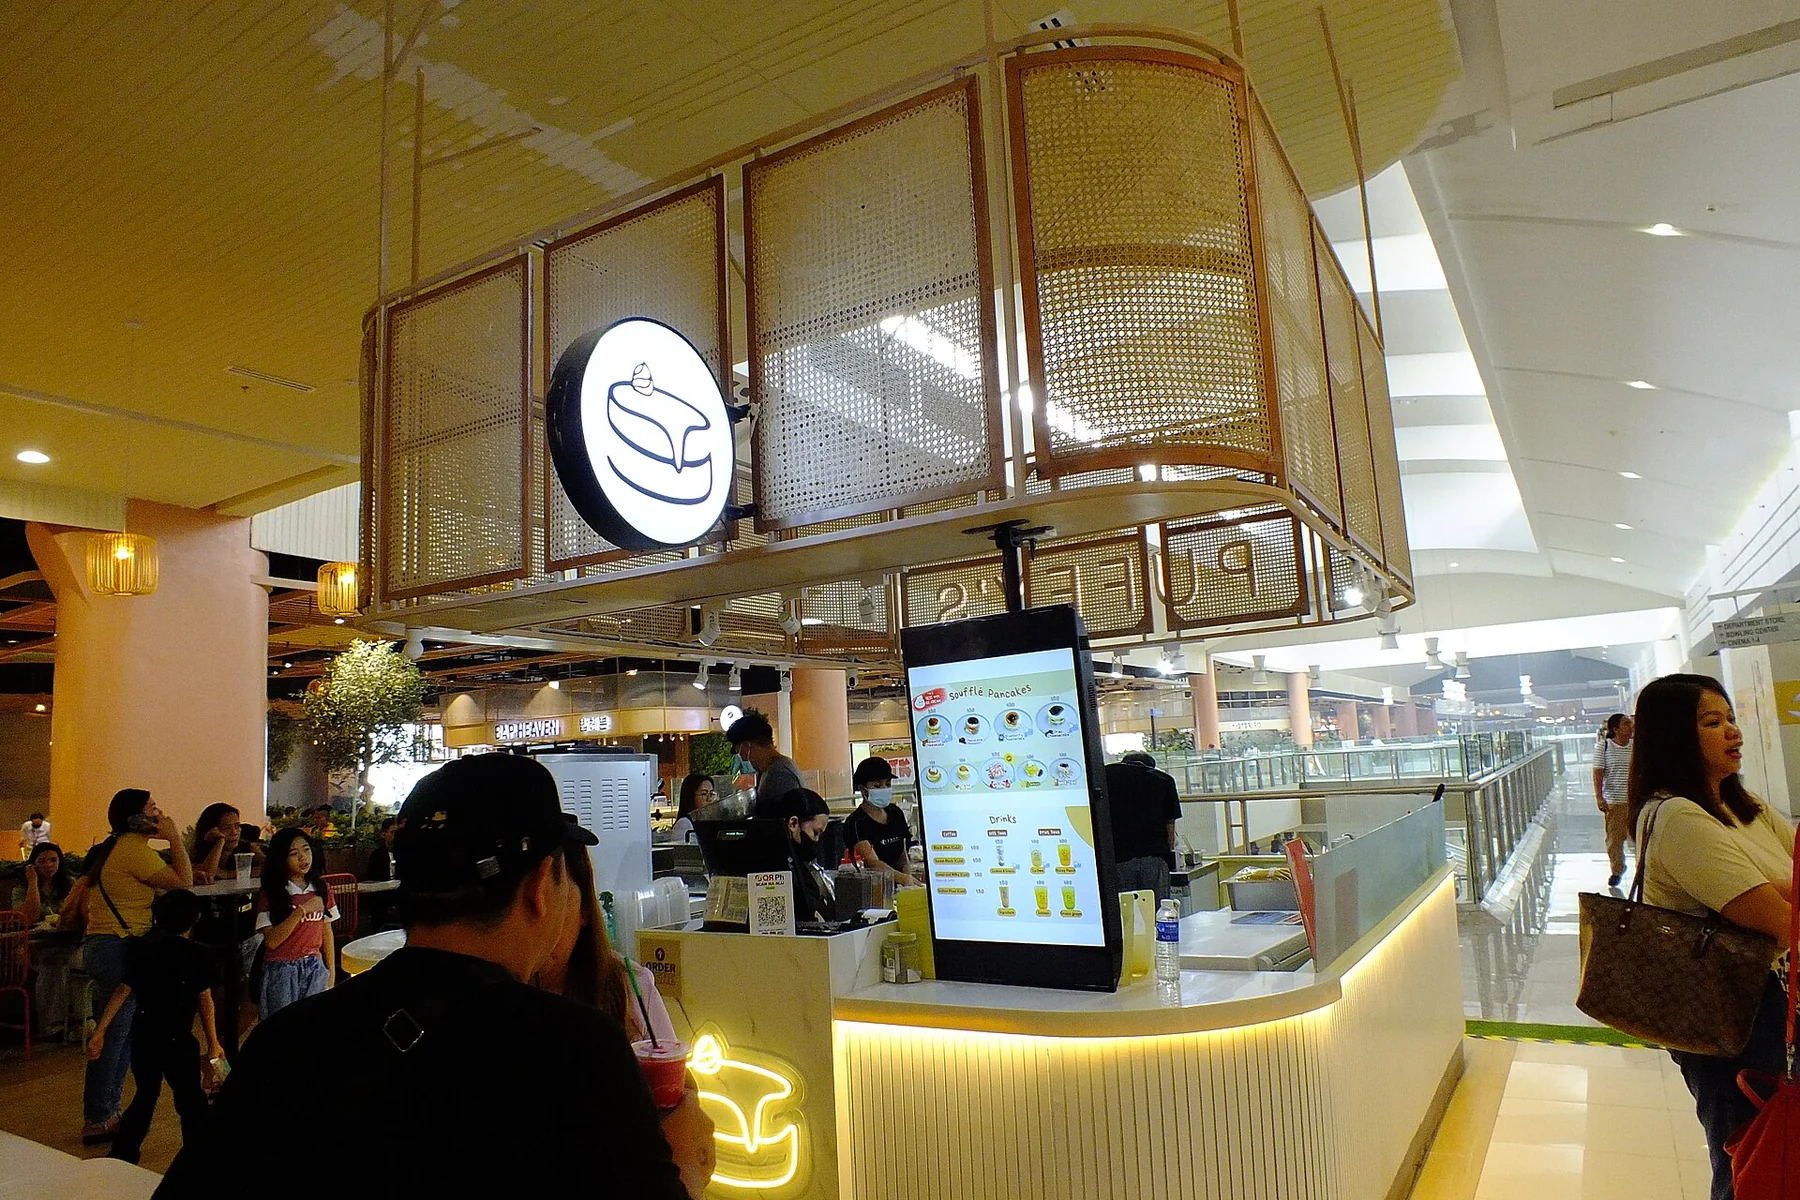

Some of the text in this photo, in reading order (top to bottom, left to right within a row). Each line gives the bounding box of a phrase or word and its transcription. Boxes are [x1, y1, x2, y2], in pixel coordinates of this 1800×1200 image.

[1724, 616, 1785, 630] DEPARTMENT STORE
[1726, 626, 1779, 638] BOWLING CENTER
[1728, 638, 1751, 646] CINEMA
[948, 686, 984, 701] Soufflé
[988, 684, 1032, 699] Pancakes
[517, 719, 561, 738] HEAVEN
[989, 814, 1017, 825] Drinks
[645, 962, 676, 973] ORDER
